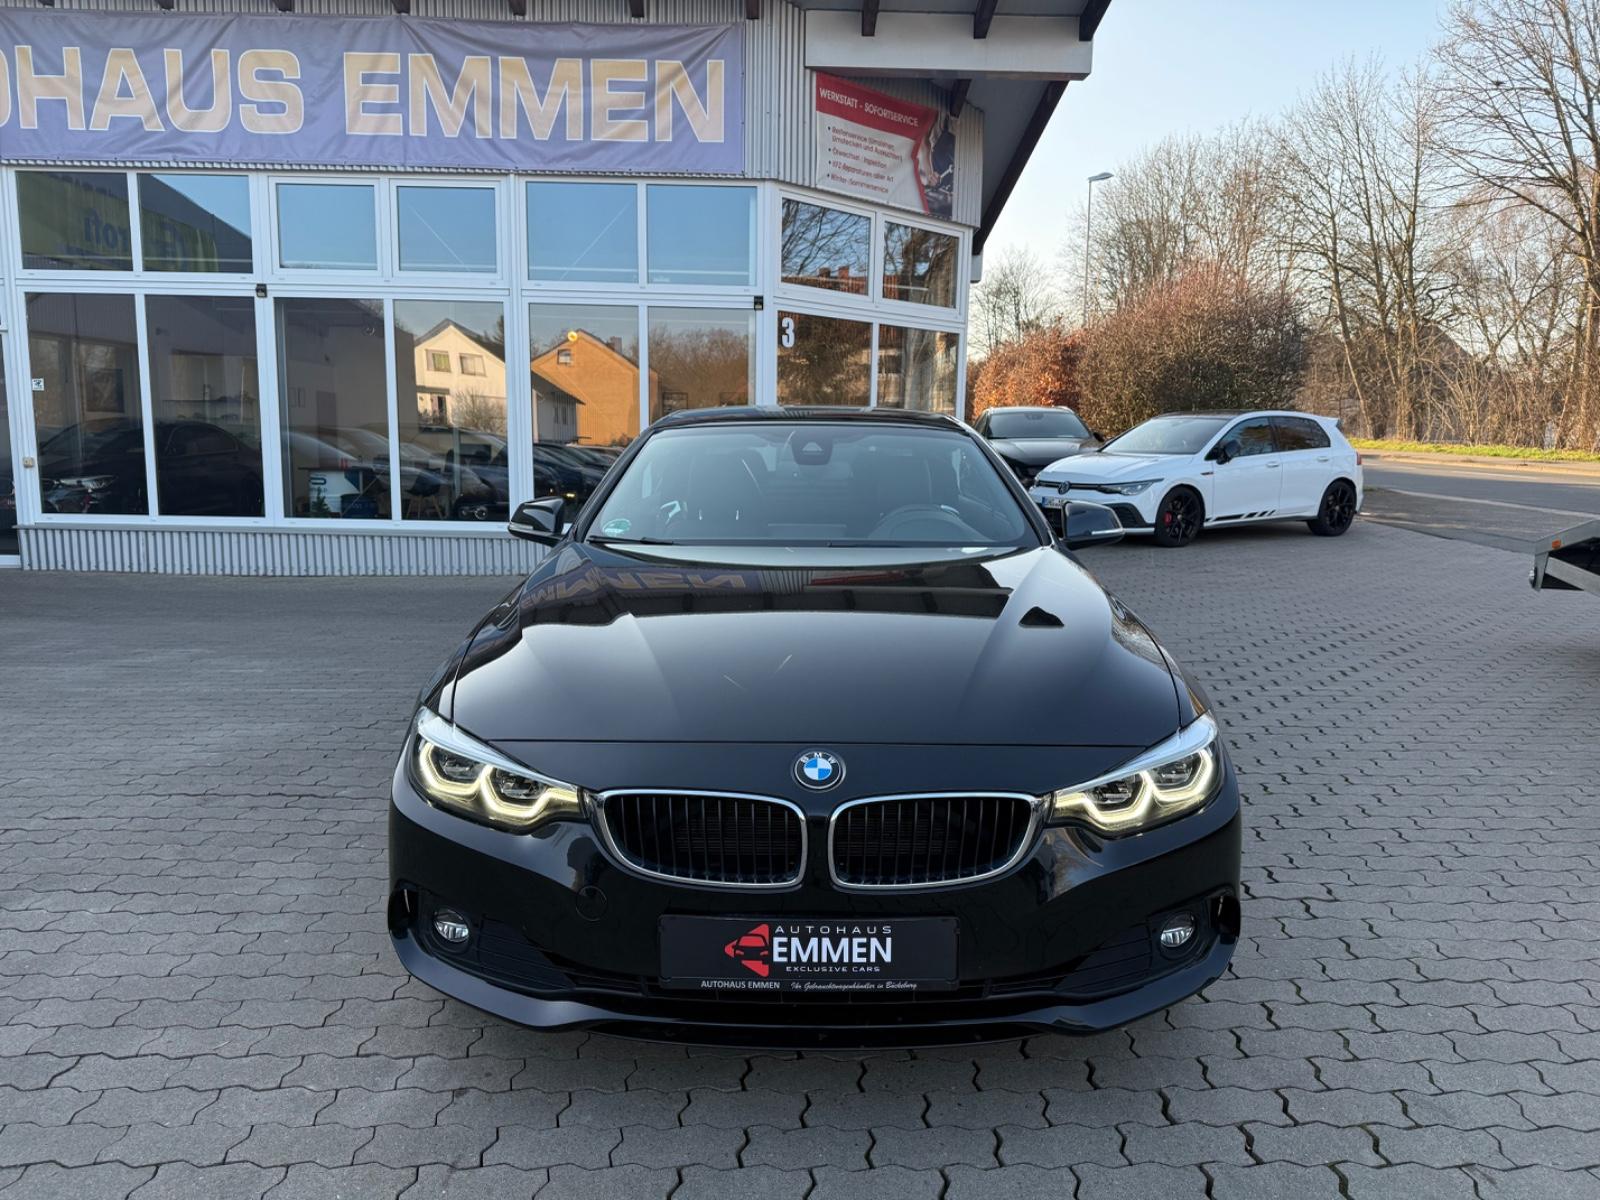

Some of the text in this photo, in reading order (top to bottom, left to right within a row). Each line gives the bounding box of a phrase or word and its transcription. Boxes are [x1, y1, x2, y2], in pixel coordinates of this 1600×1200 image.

[0, 45, 724, 143] HAUS EMMEN
[819, 87, 858, 109] WERKSTATT
[864, 102, 919, 127] SOFORTSERVICE
[782, 317, 795, 348] 3
[775, 925, 892, 934] AUTOHAUS
[773, 937, 892, 963] EMMEN
[701, 980, 780, 989] AUTOHAUS EMMEN
